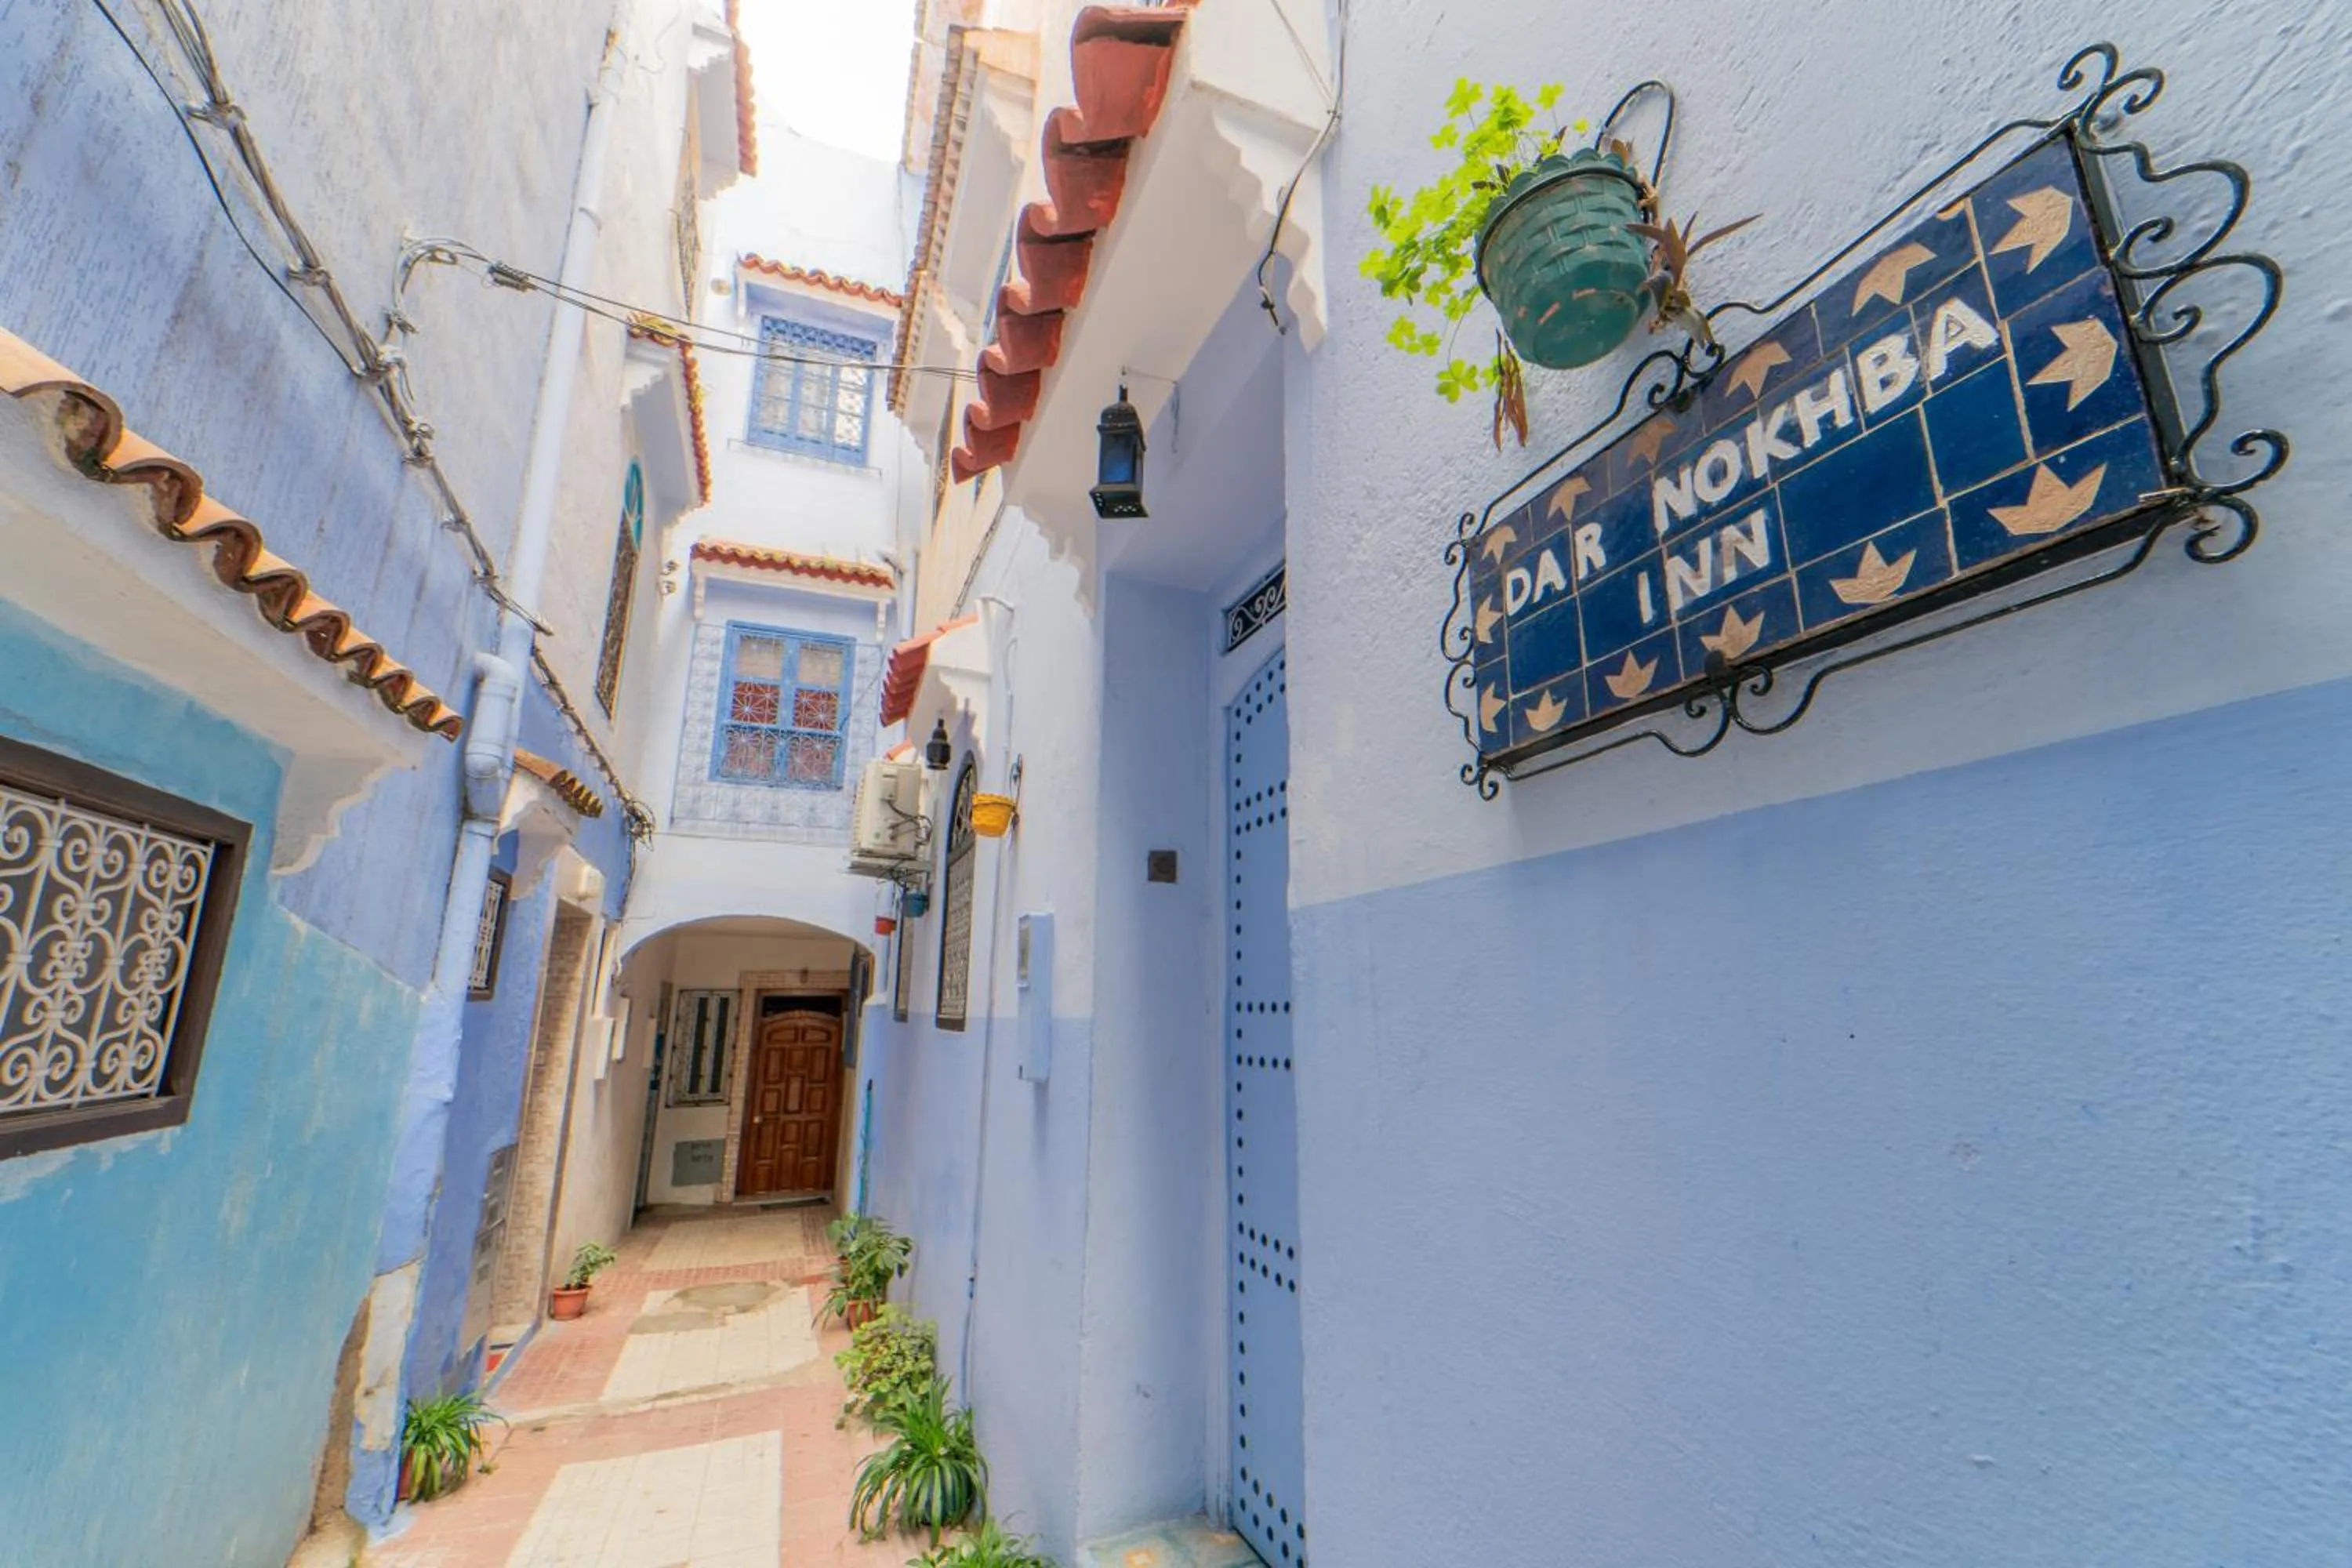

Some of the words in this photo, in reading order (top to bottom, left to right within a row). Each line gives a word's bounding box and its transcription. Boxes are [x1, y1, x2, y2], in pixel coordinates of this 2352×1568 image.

[1505, 522, 1606, 617] DAR
[1653, 297, 1999, 536] NOKHBA
[1637, 509, 1769, 625] INN
